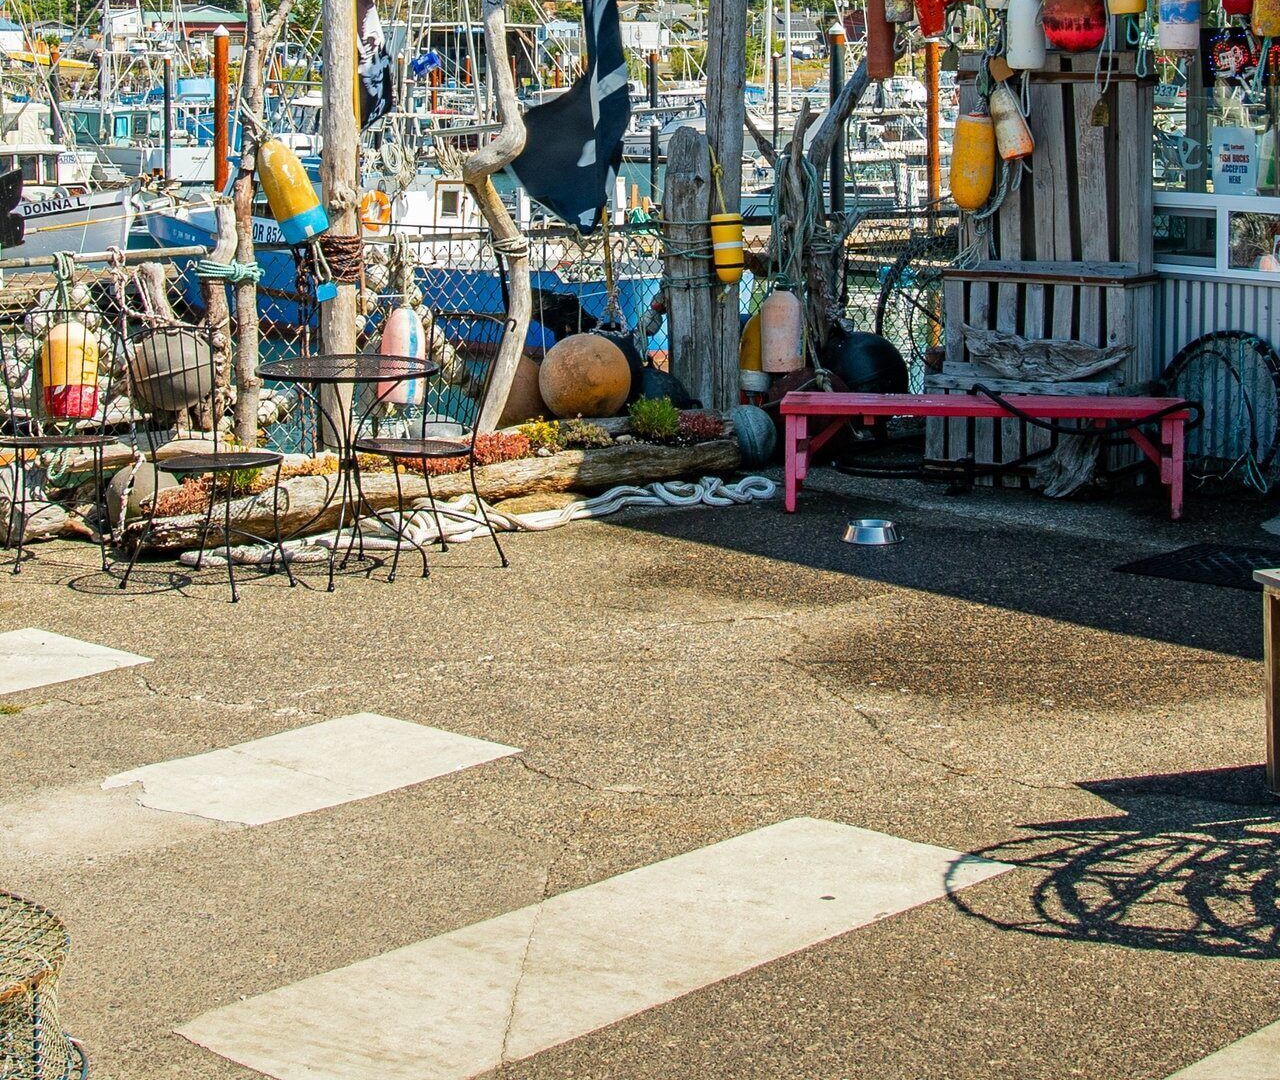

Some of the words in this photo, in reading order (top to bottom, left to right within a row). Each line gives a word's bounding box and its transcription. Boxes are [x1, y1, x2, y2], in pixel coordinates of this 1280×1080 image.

[1229, 175, 1242, 184] HERE
[23, 201, 72, 216] DONNA
[76, 196, 86, 207] L
[252, 223, 265, 241] OR
